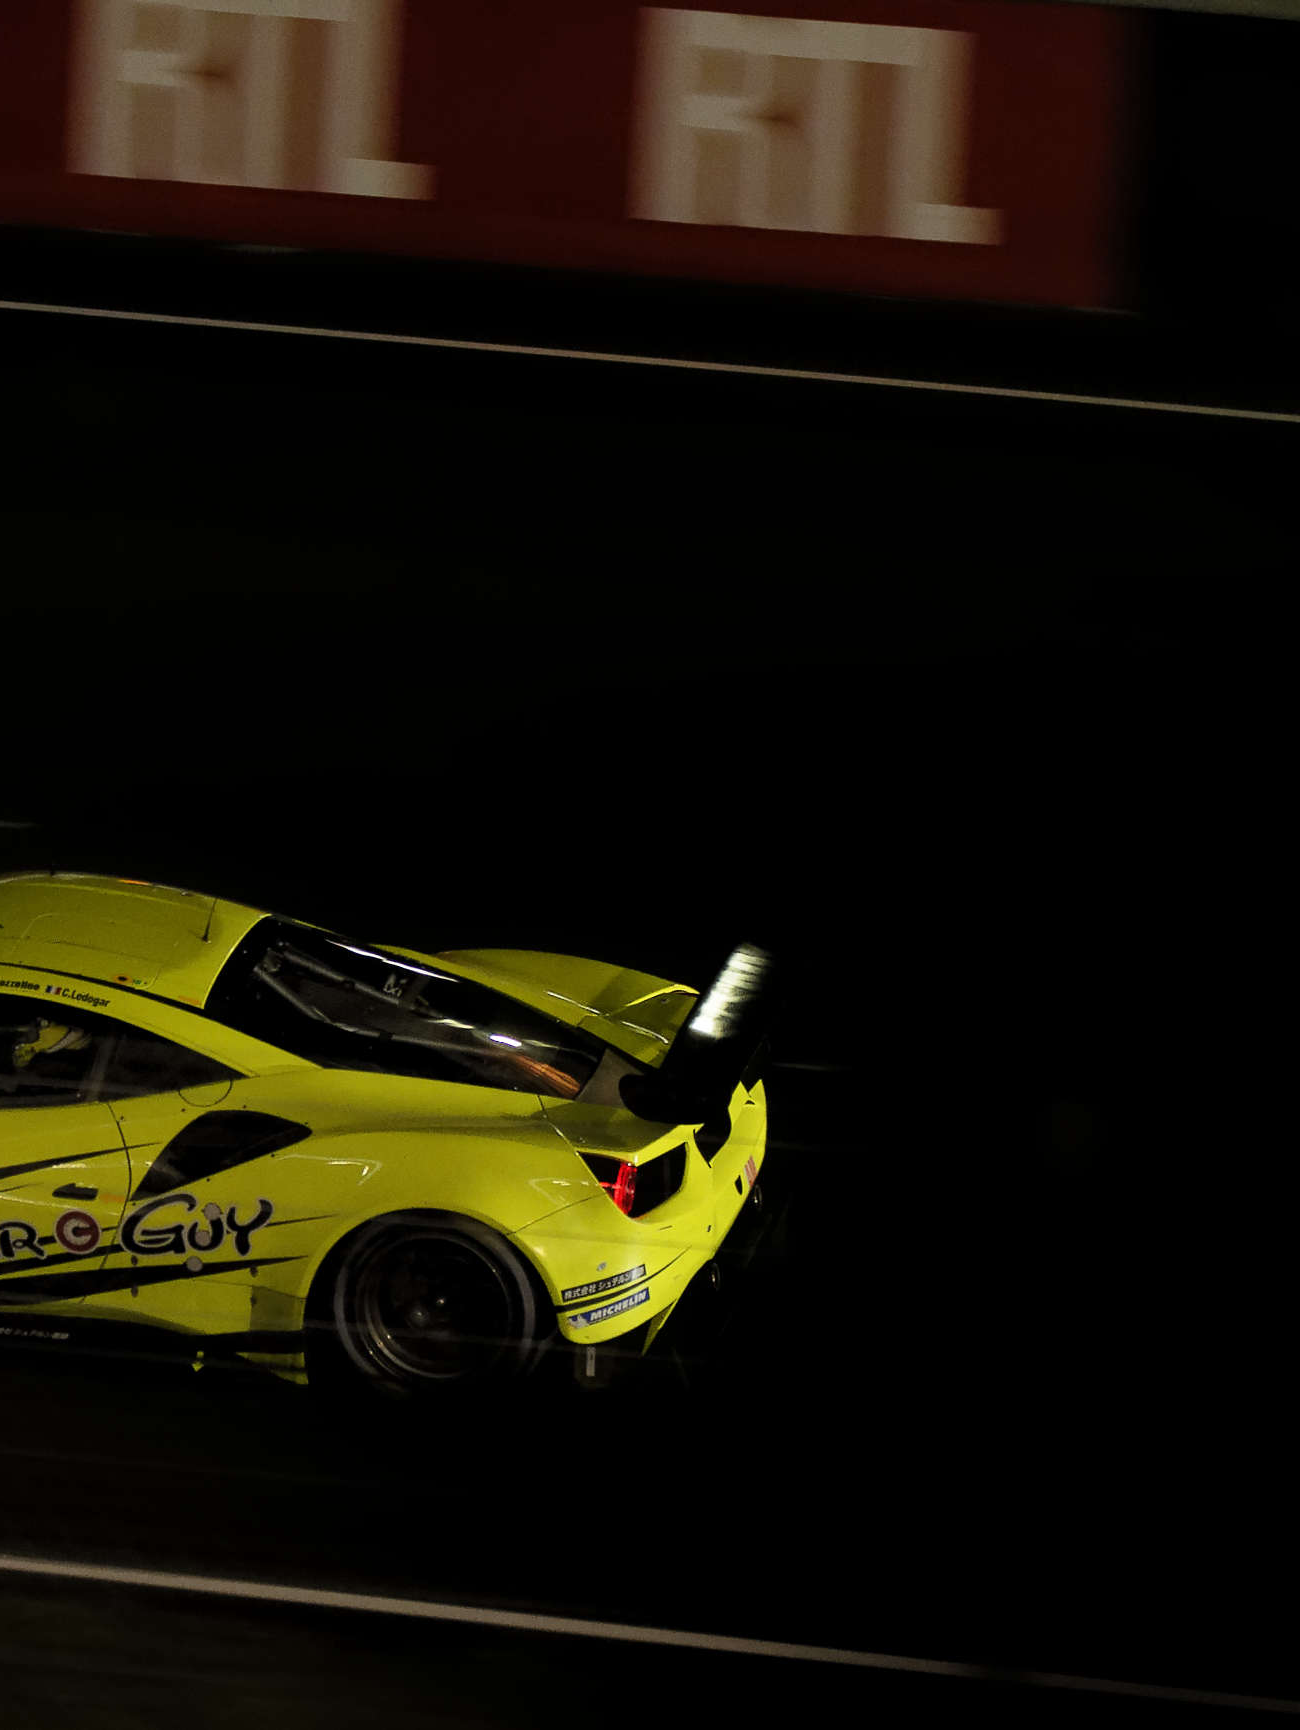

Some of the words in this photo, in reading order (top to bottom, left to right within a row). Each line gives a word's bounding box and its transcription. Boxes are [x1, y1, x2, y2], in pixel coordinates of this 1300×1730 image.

[628, 5, 1006, 246] RTL
[120, 1194, 274, 1257] GUY
[589, 1291, 647, 1321] MICHELIN
